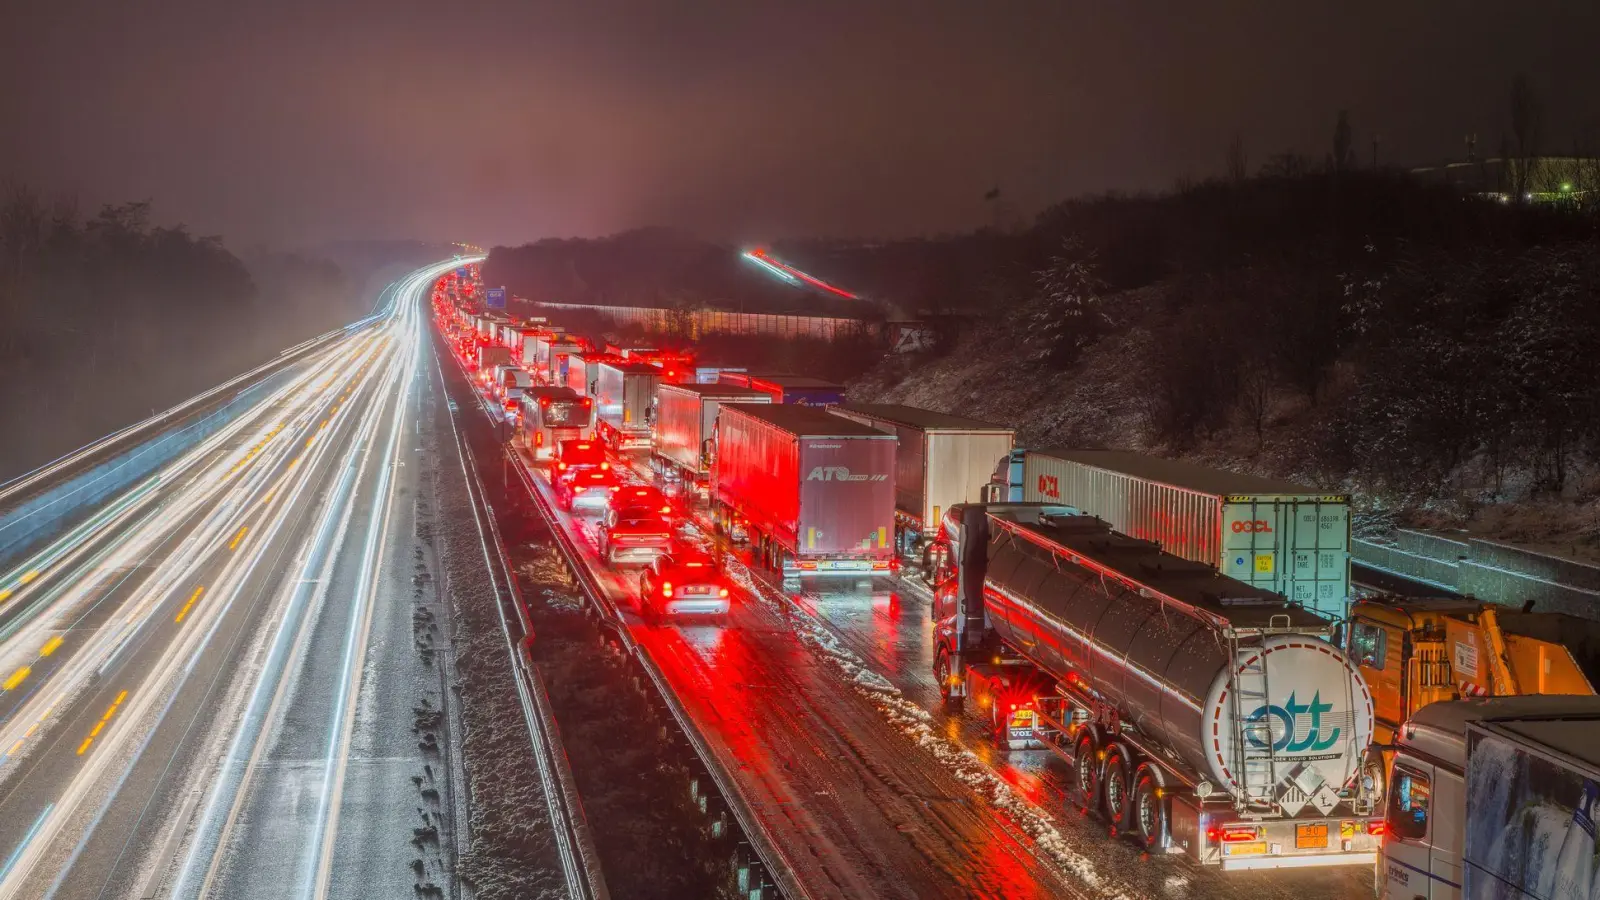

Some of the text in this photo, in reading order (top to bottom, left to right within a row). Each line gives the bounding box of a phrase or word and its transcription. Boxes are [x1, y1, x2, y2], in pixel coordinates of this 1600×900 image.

[1231, 520, 1272, 533] OOCL
[1246, 688, 1341, 752] ott
[1306, 826, 1319, 835] 90
